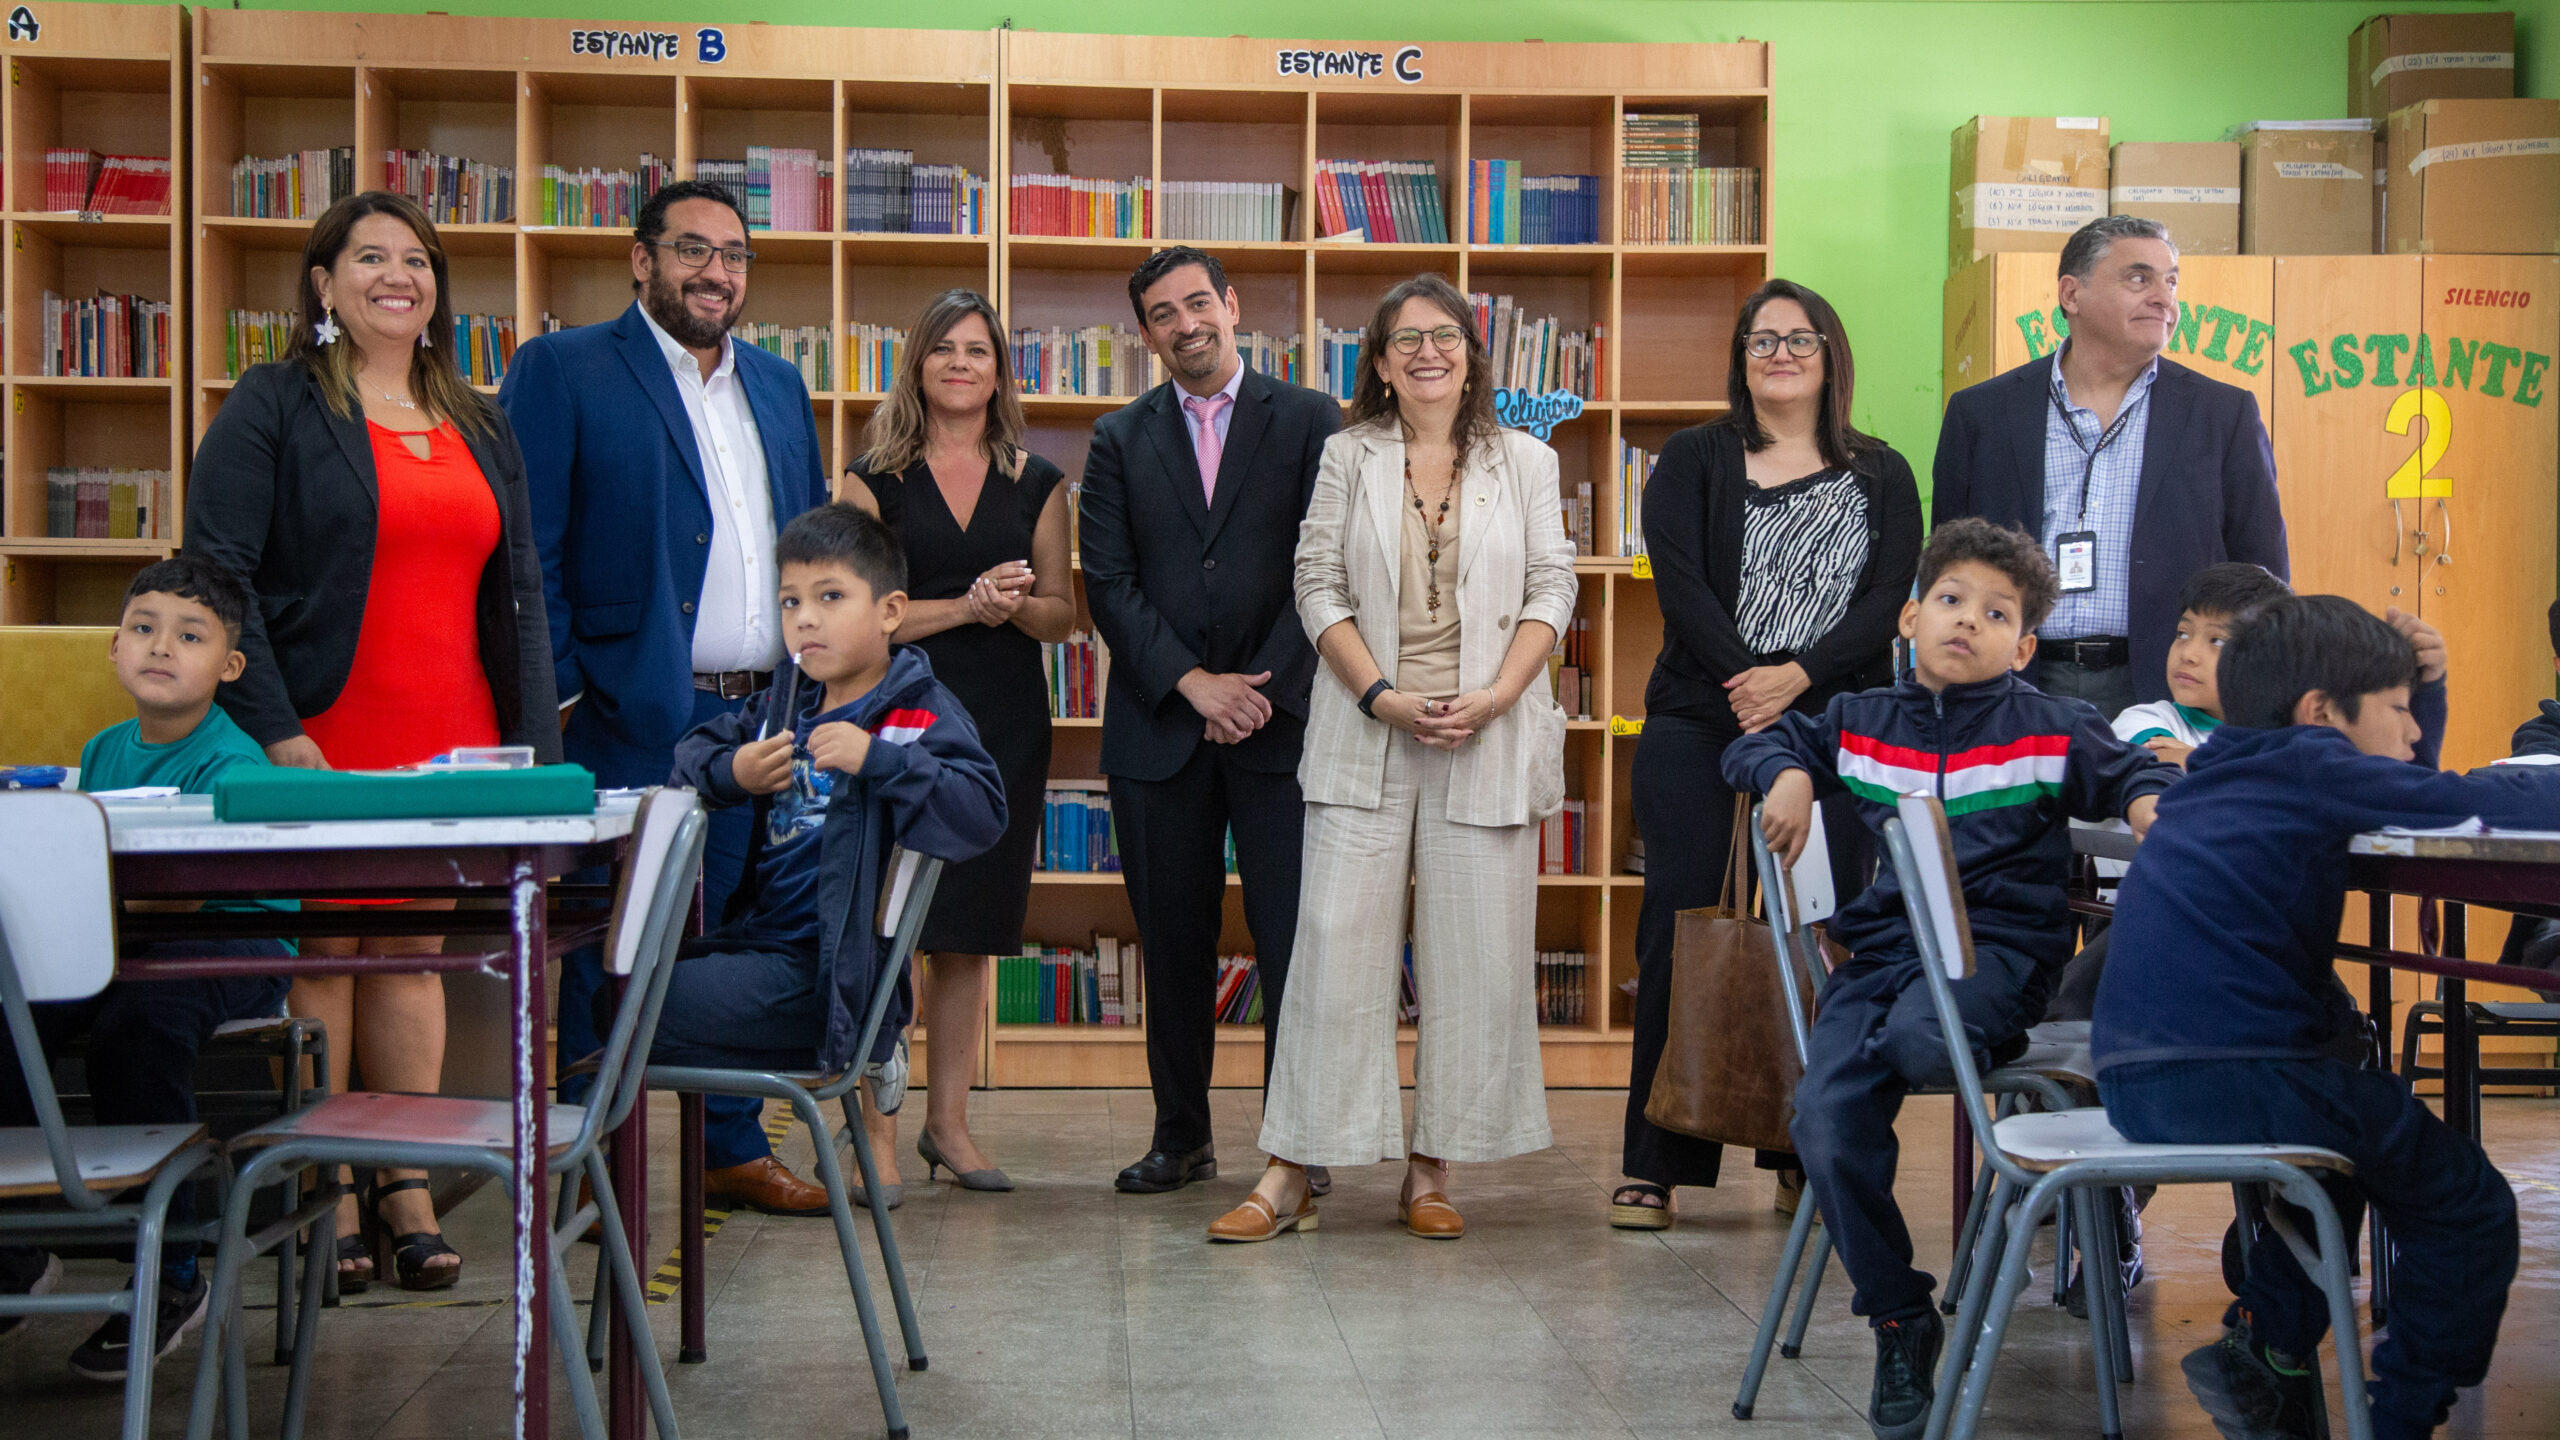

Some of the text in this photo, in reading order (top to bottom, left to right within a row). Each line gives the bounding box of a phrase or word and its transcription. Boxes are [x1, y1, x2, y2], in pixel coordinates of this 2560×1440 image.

[9, 6, 40, 41] A
[572, 29, 726, 62] ESTANTE B
[1279, 49, 1422, 81] ESTANTE C
[2507, 143, 2513, 153] Y
[2445, 288, 2531, 308] SILENCIO
[2288, 333, 2550, 408] ESTANTE
[2385, 388, 2453, 499] 2
